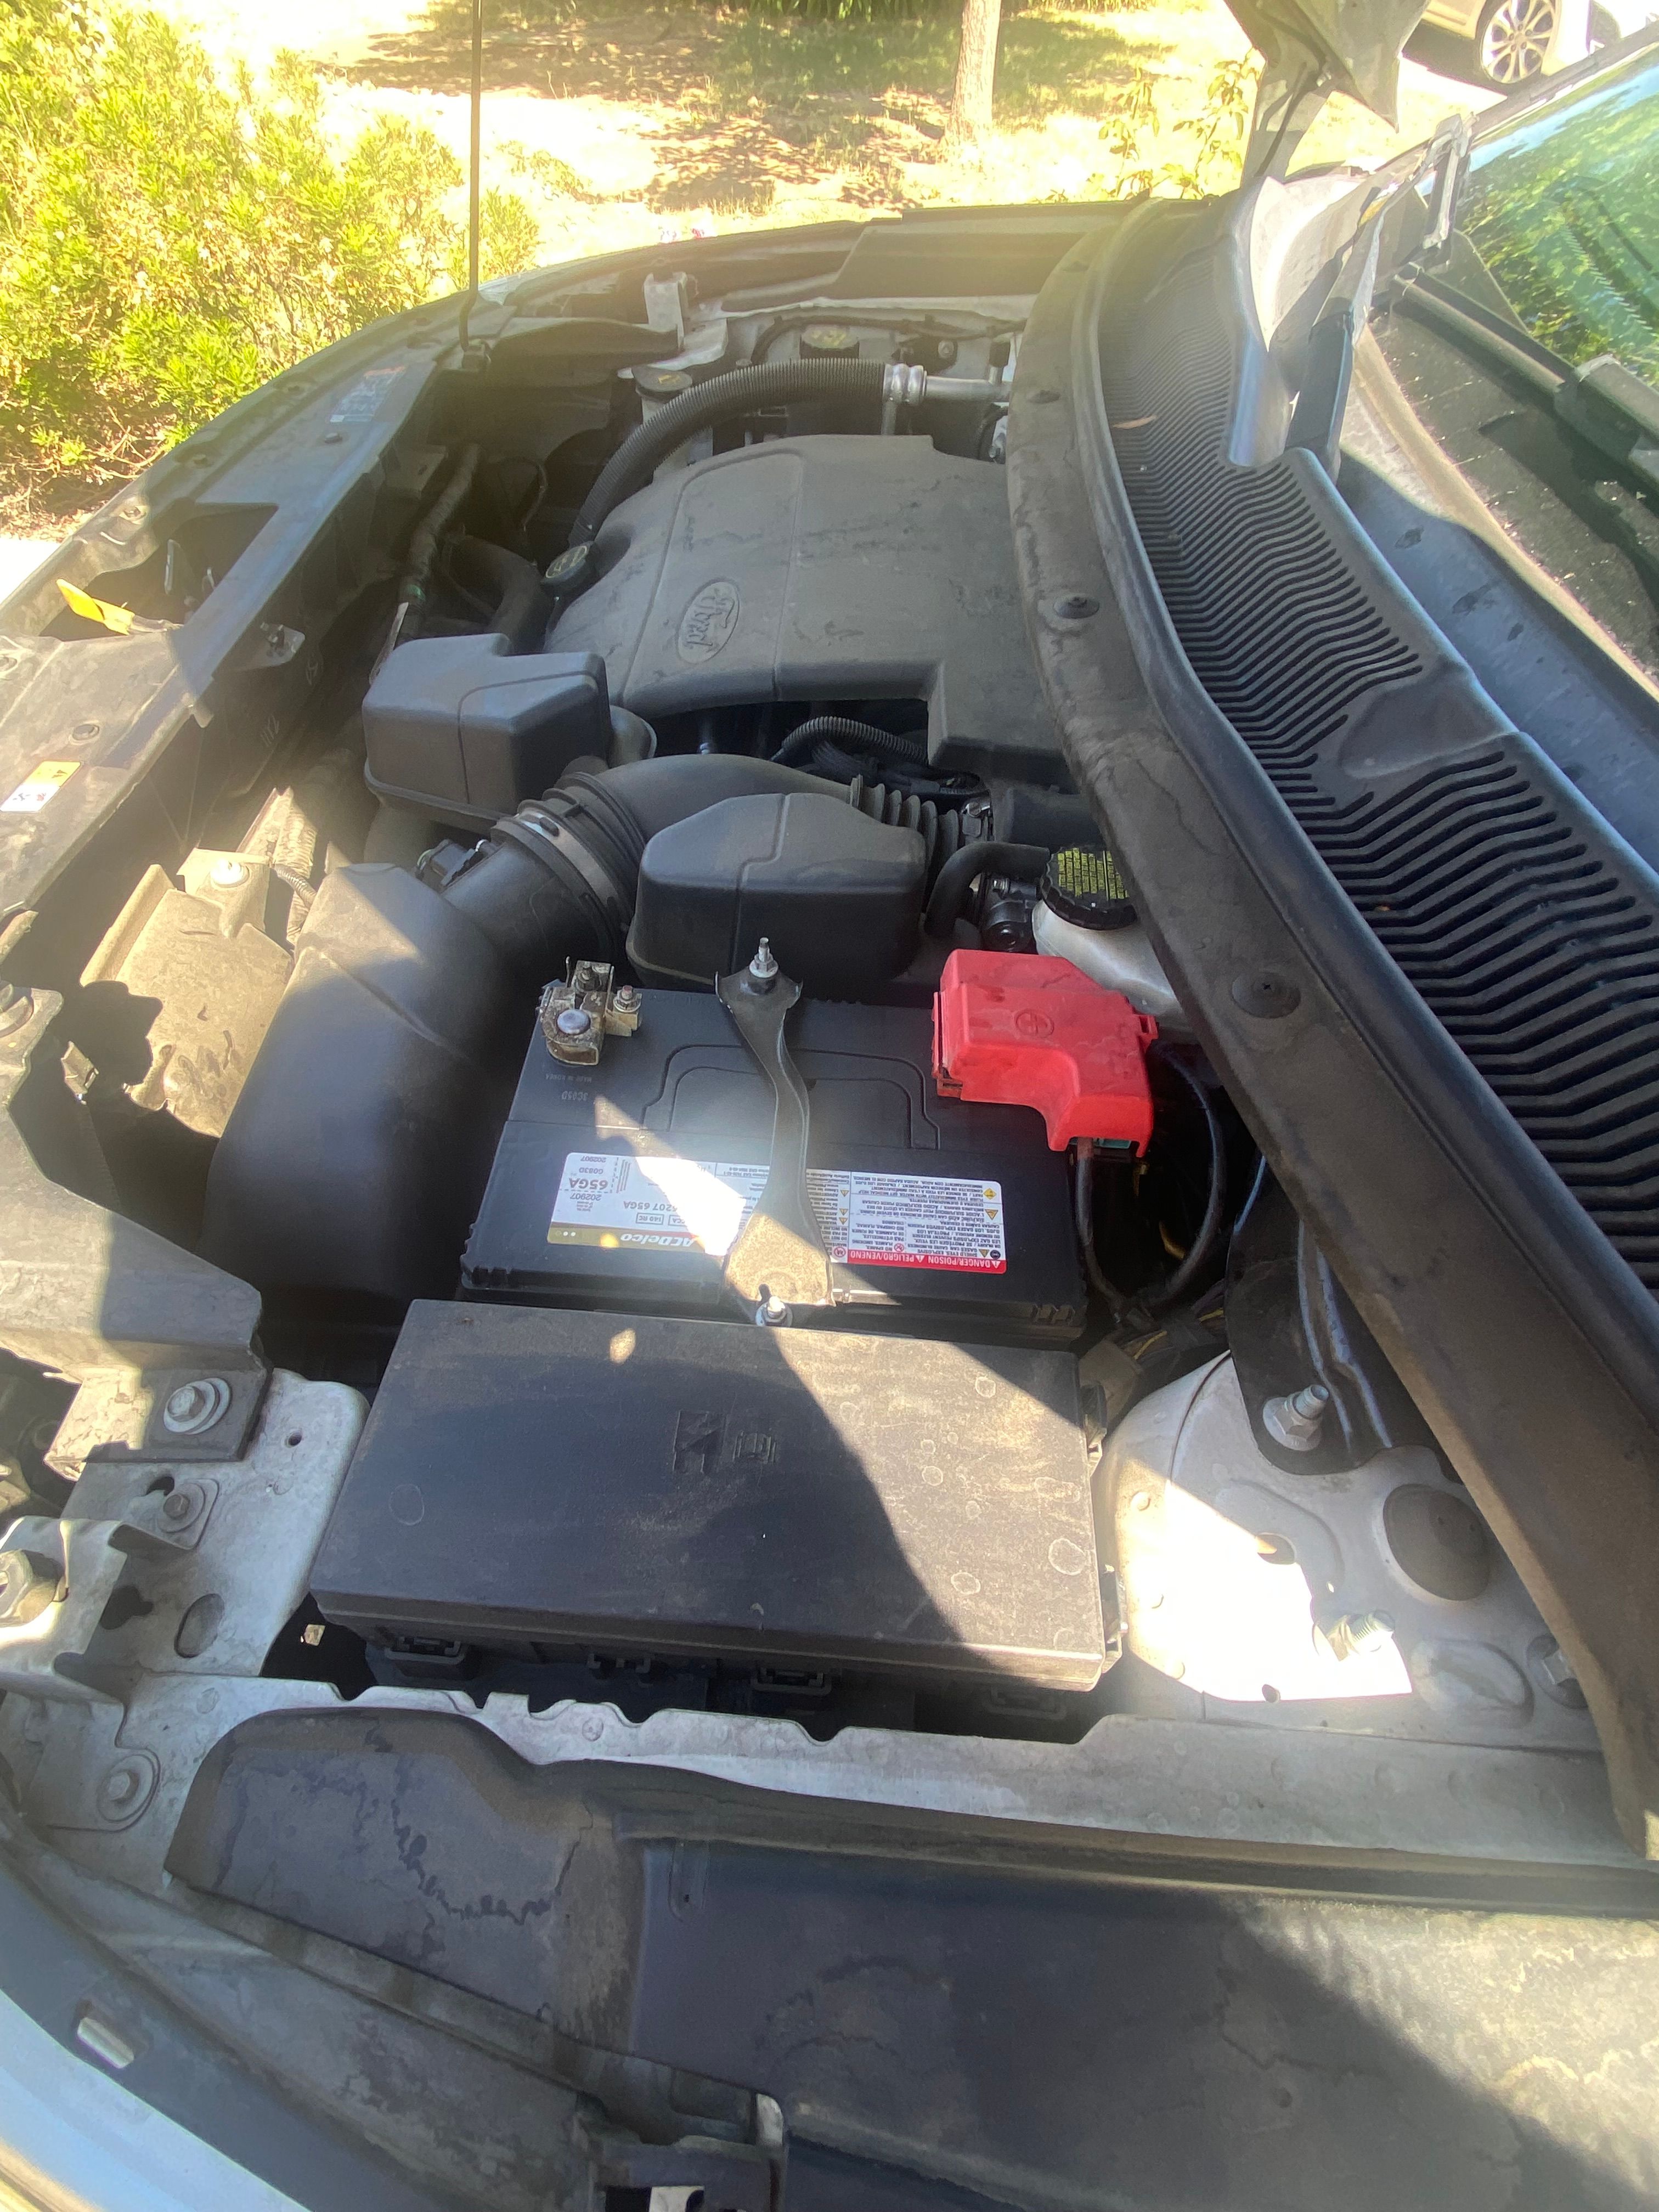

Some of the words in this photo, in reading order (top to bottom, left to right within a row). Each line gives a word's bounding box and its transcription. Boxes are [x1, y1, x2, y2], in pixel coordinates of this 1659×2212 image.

[684, 586, 736, 653] Ford
[567, 1177, 608, 1190] 65GA
[622, 1201, 650, 1210] 65GA
[620, 1233, 693, 1247] ACDelco
[850, 1250, 914, 1262] PELIGRO/VENENO
[928, 1256, 990, 1267] DANGER/POISON
